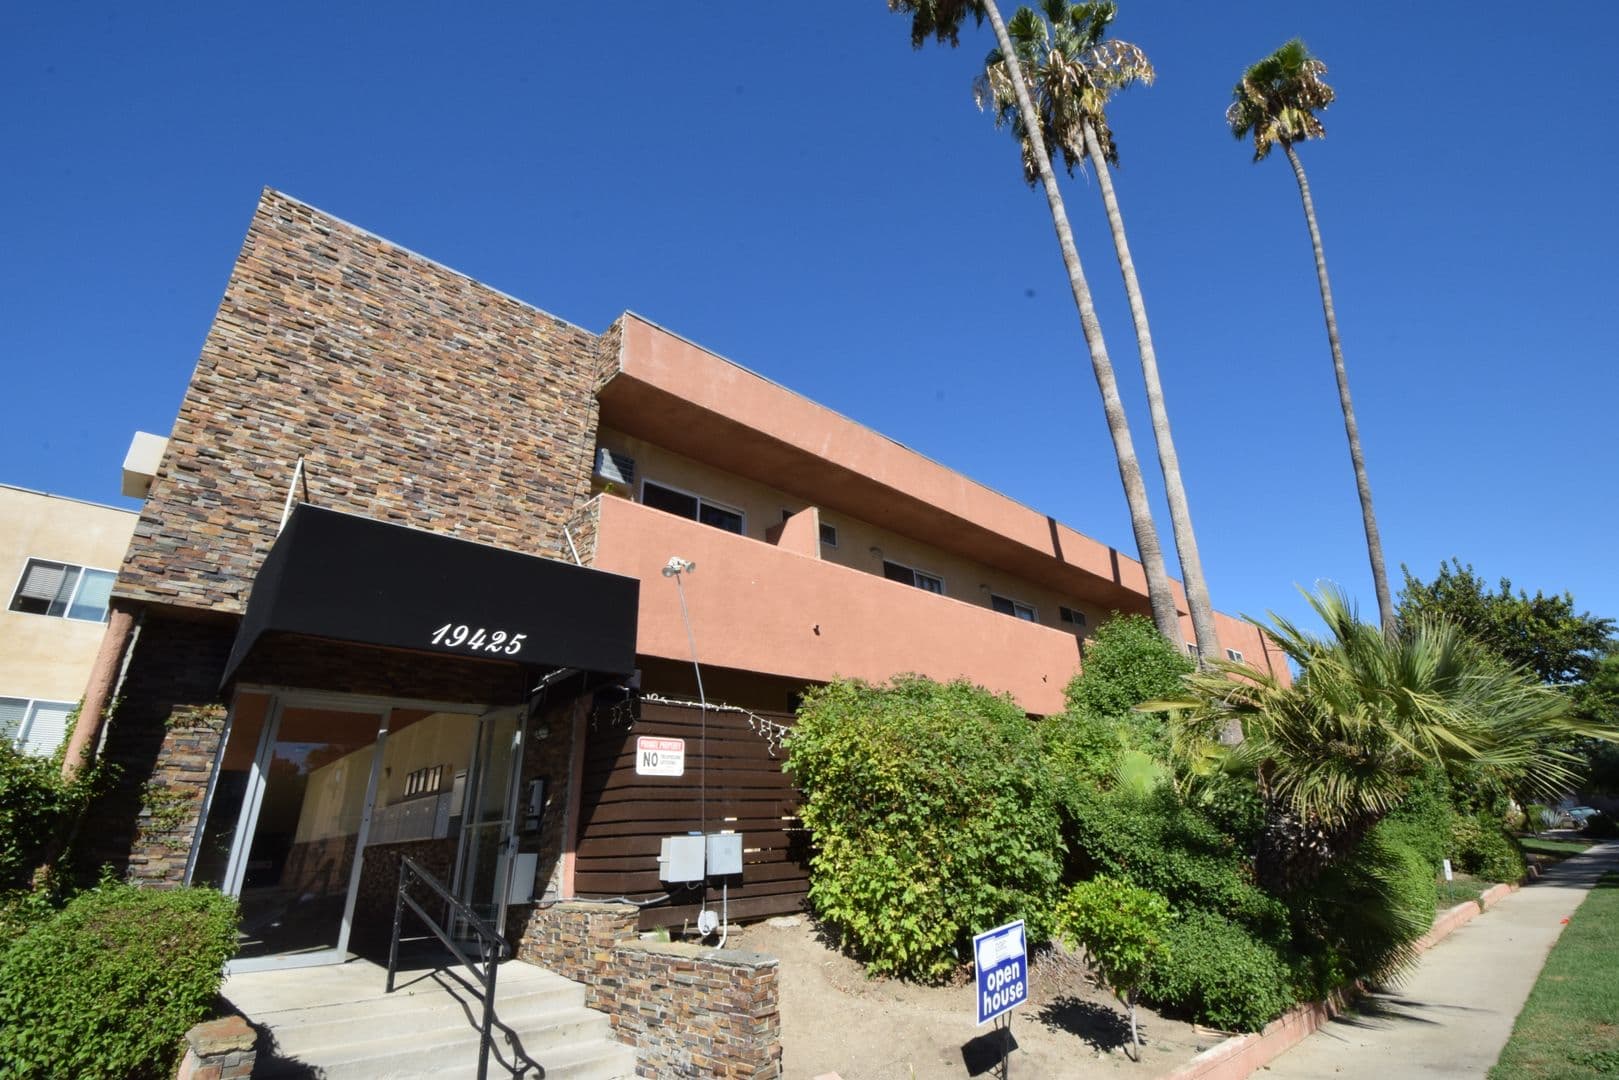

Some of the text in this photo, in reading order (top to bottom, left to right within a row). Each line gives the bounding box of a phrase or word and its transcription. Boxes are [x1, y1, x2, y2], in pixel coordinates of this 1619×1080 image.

[431, 623, 527, 654] 19425
[642, 751, 658, 767] NO
[987, 961, 1020, 992] open
[983, 981, 1024, 1016] house
